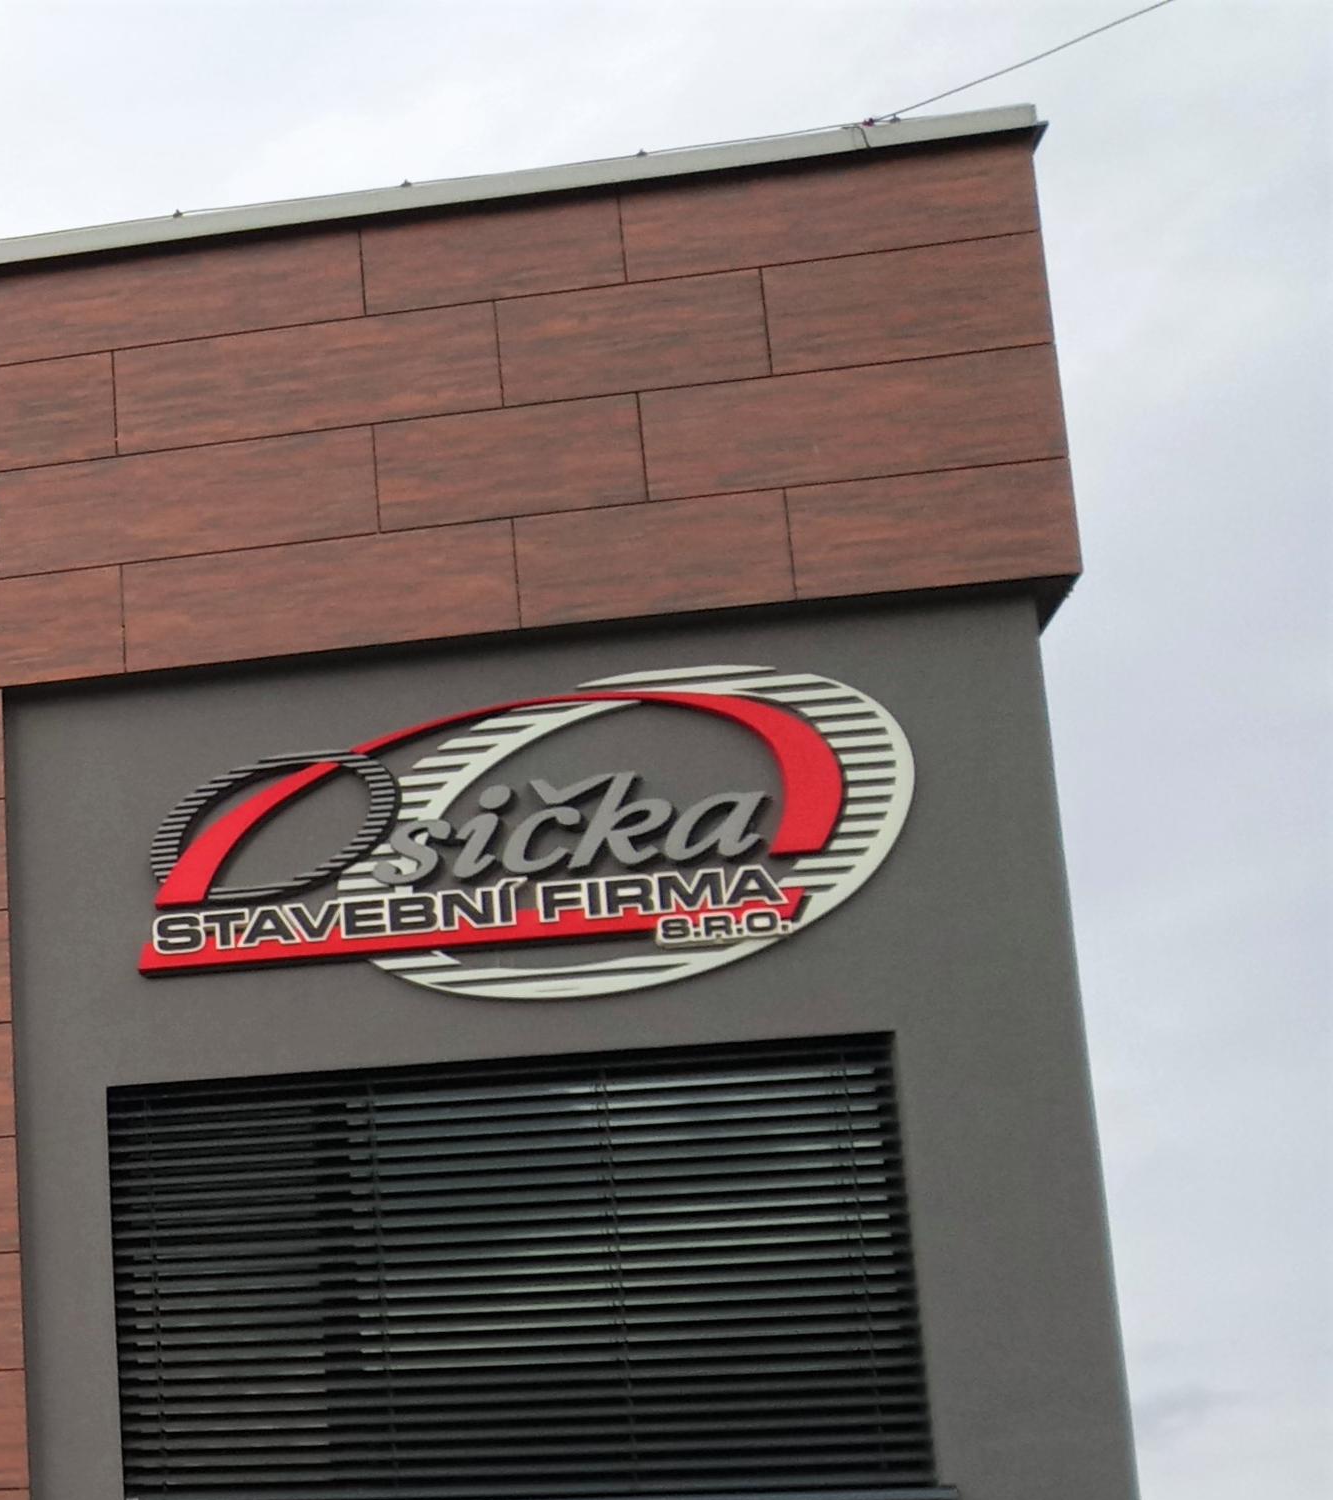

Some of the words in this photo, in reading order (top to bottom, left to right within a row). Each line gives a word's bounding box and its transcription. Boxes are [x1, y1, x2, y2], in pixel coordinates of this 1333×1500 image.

[154, 877, 527, 954] STAVEBNÍ
[537, 865, 788, 919] FIRMA
[658, 910, 791, 941] S.R.O.
